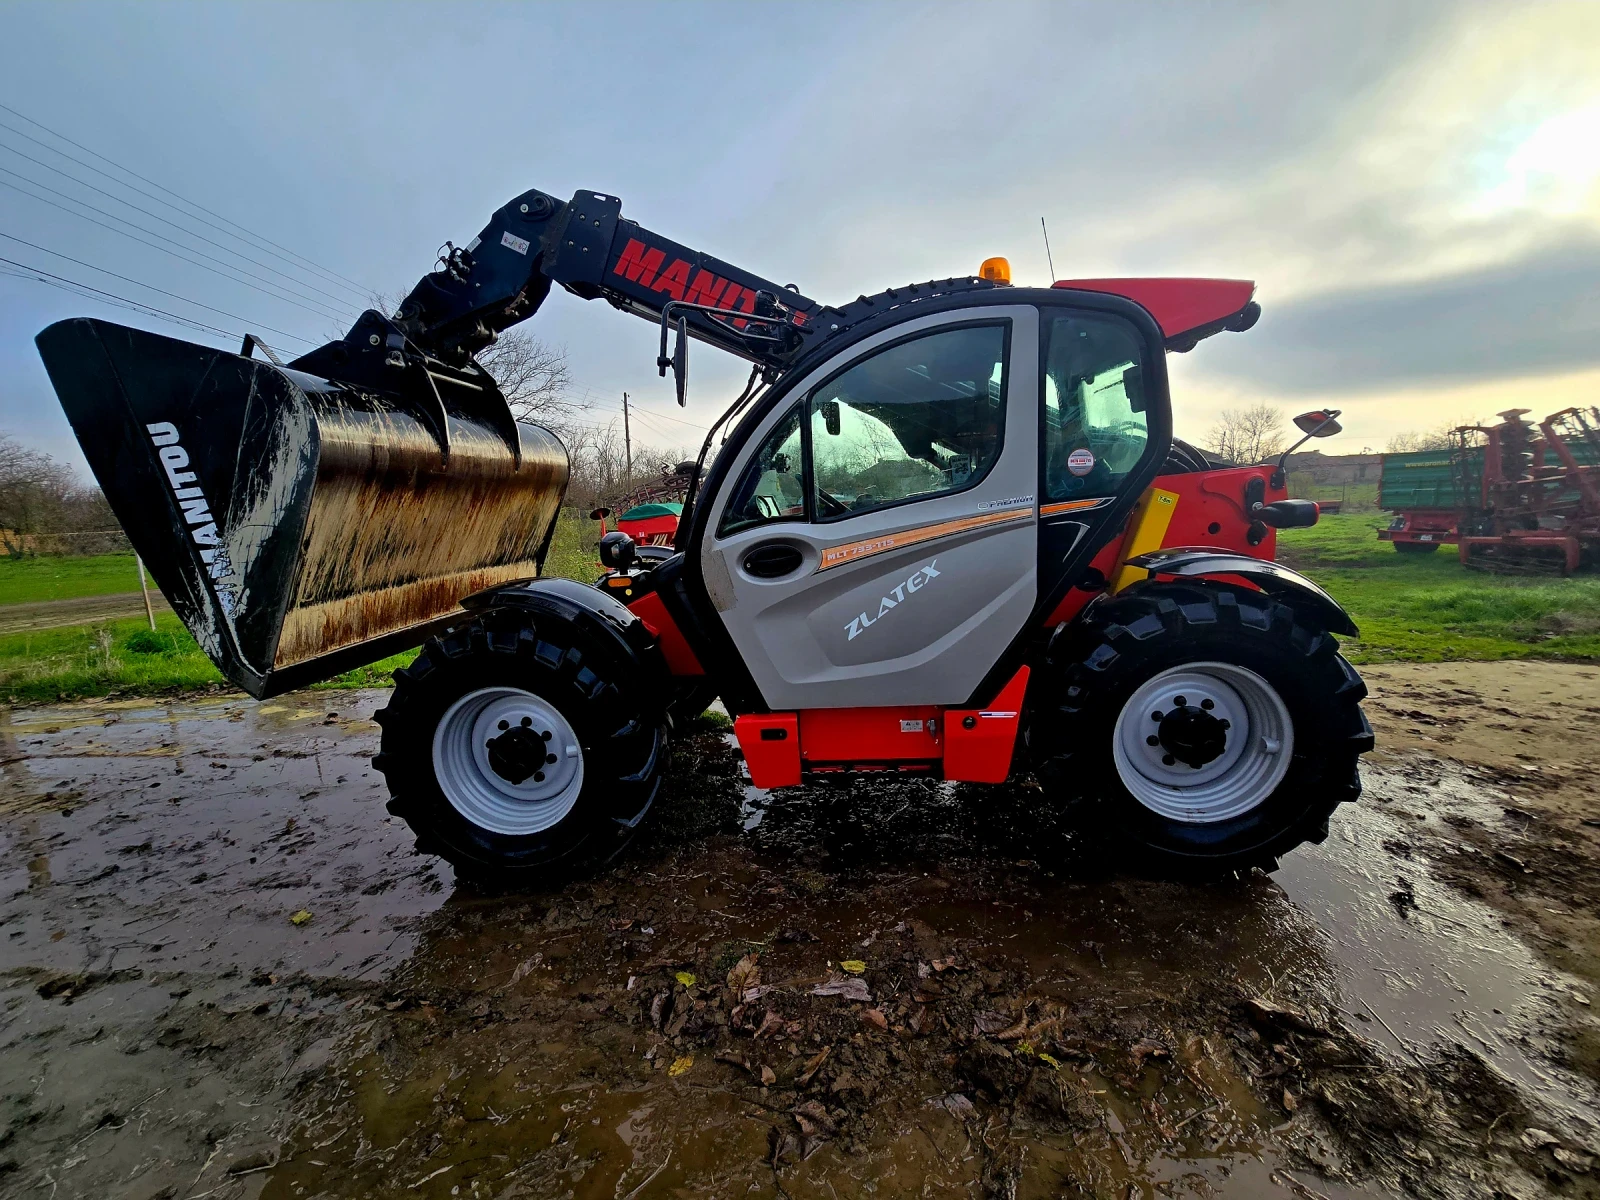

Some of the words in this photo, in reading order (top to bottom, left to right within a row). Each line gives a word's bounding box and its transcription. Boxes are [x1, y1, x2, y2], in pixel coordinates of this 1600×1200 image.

[613, 237, 814, 329] MANIT
[990, 494, 1033, 508] PREMIUM
[827, 550, 848, 561] MLT
[843, 559, 942, 641] ZLATEX
